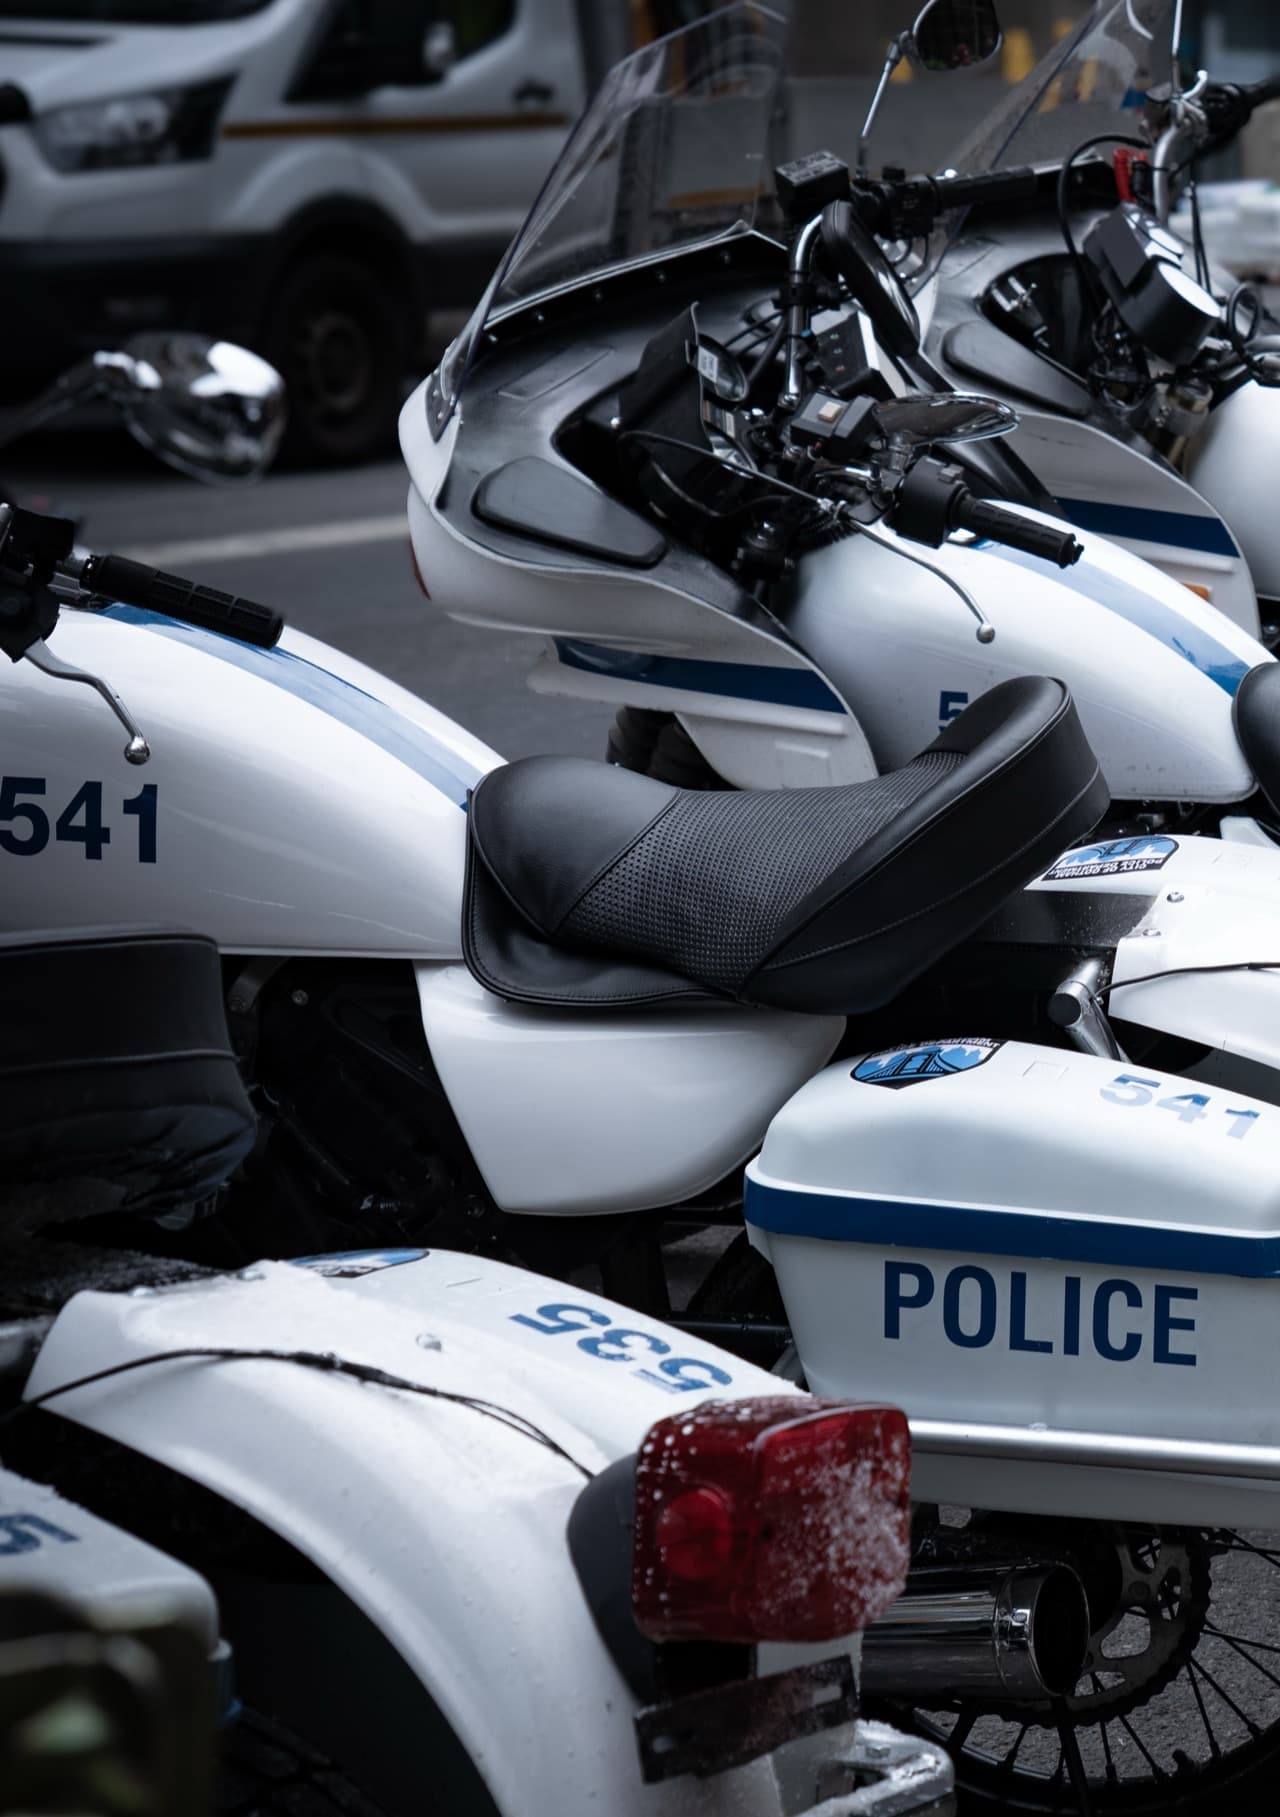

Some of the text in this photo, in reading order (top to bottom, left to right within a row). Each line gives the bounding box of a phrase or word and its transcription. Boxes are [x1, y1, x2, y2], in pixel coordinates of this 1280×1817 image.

[0, 776, 158, 864] 541
[1099, 1074, 1261, 1139] 541
[509, 1303, 733, 1394] 535
[884, 1260, 1199, 1366] POLICE
